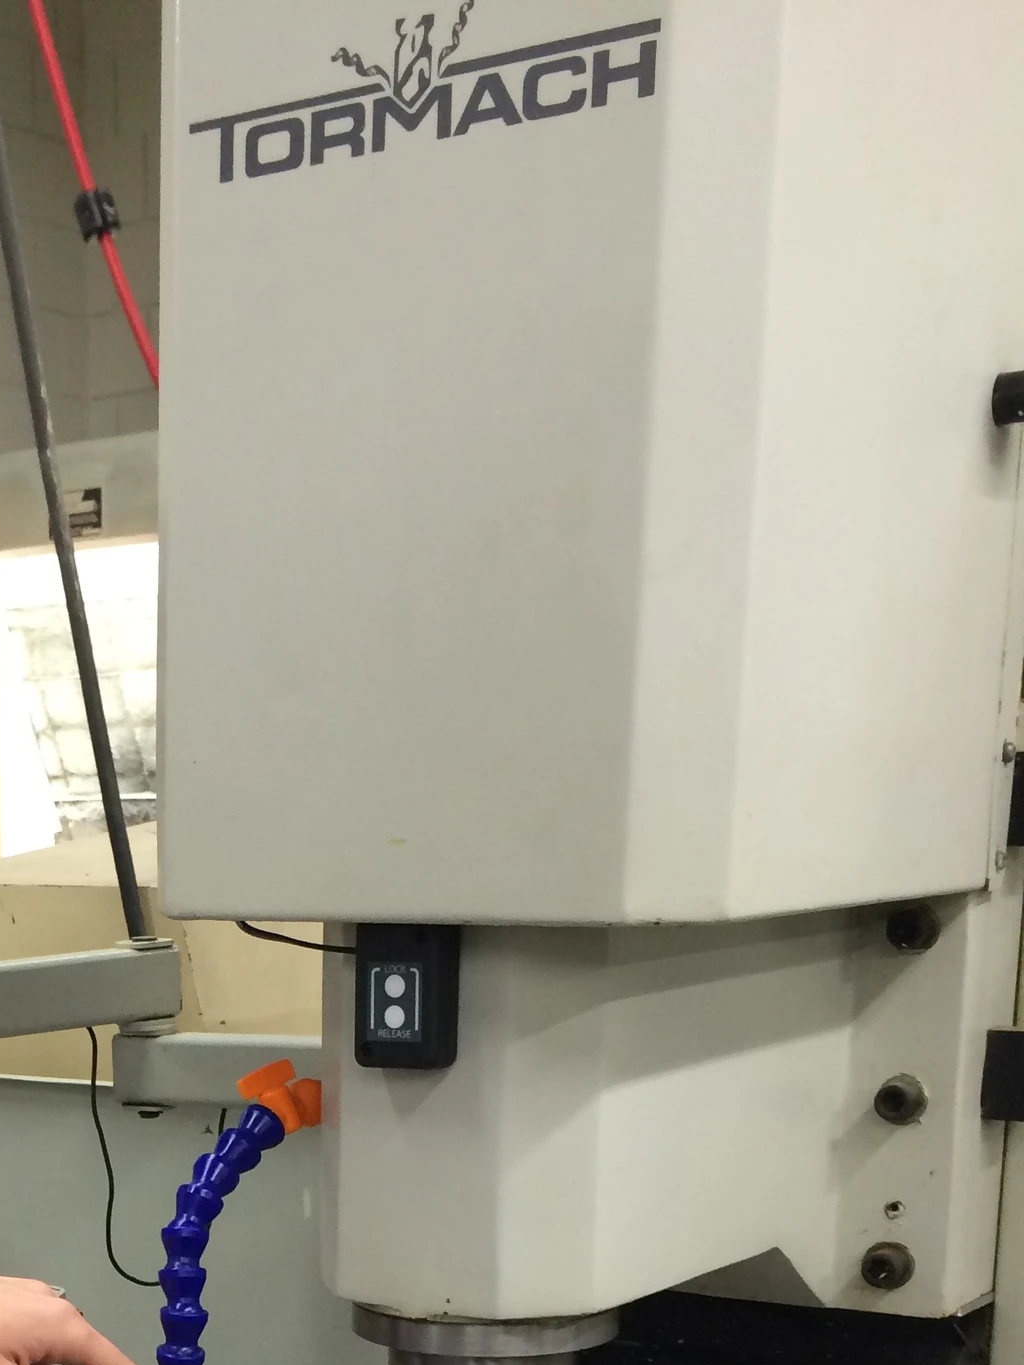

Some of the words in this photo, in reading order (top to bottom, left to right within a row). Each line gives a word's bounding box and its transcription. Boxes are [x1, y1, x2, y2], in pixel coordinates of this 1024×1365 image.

[189, 36, 660, 184] TORMACH
[384, 964, 406, 974] LOCK
[378, 1029, 411, 1038] RELEASE
